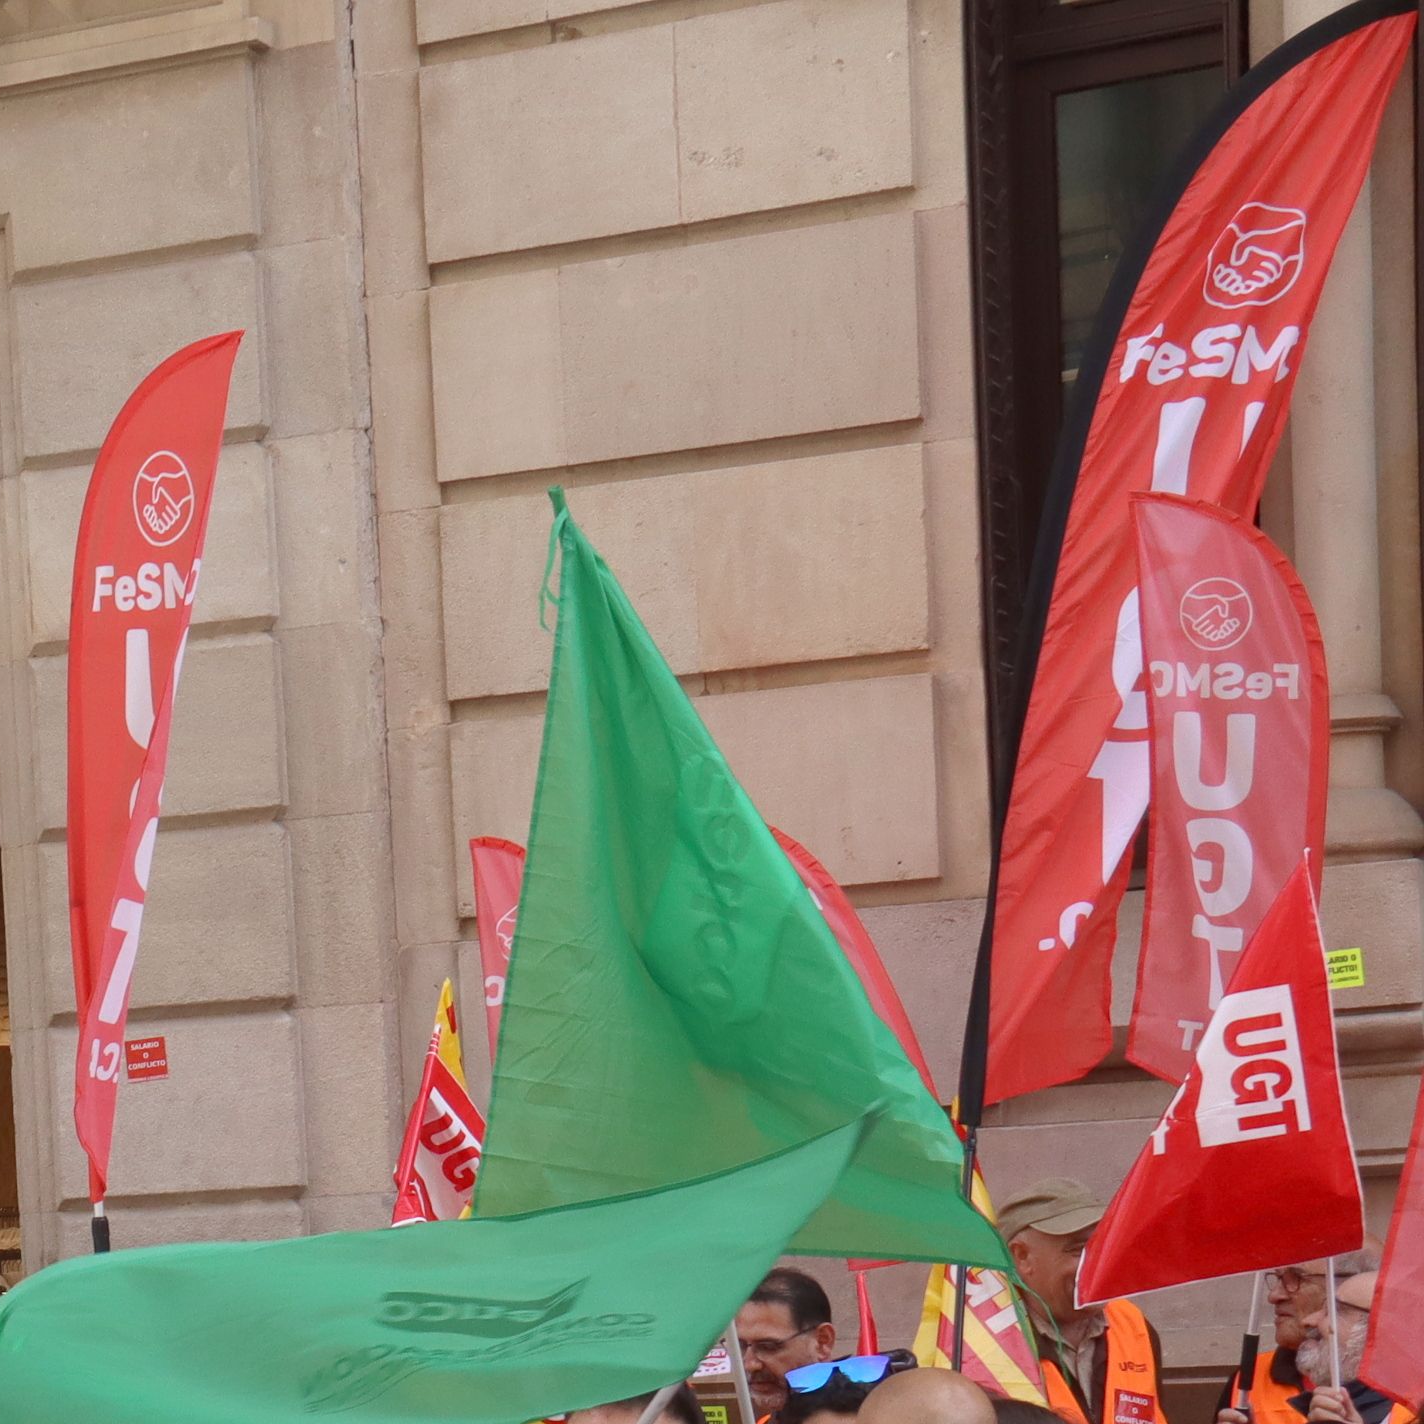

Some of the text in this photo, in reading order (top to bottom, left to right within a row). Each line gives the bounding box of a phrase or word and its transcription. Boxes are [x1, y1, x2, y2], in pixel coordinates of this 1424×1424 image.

[130, 1041, 160, 1051] SALARIO
[128, 1060, 166, 1070] CONFLICTO
[1223, 1012, 1289, 1141] UGT
